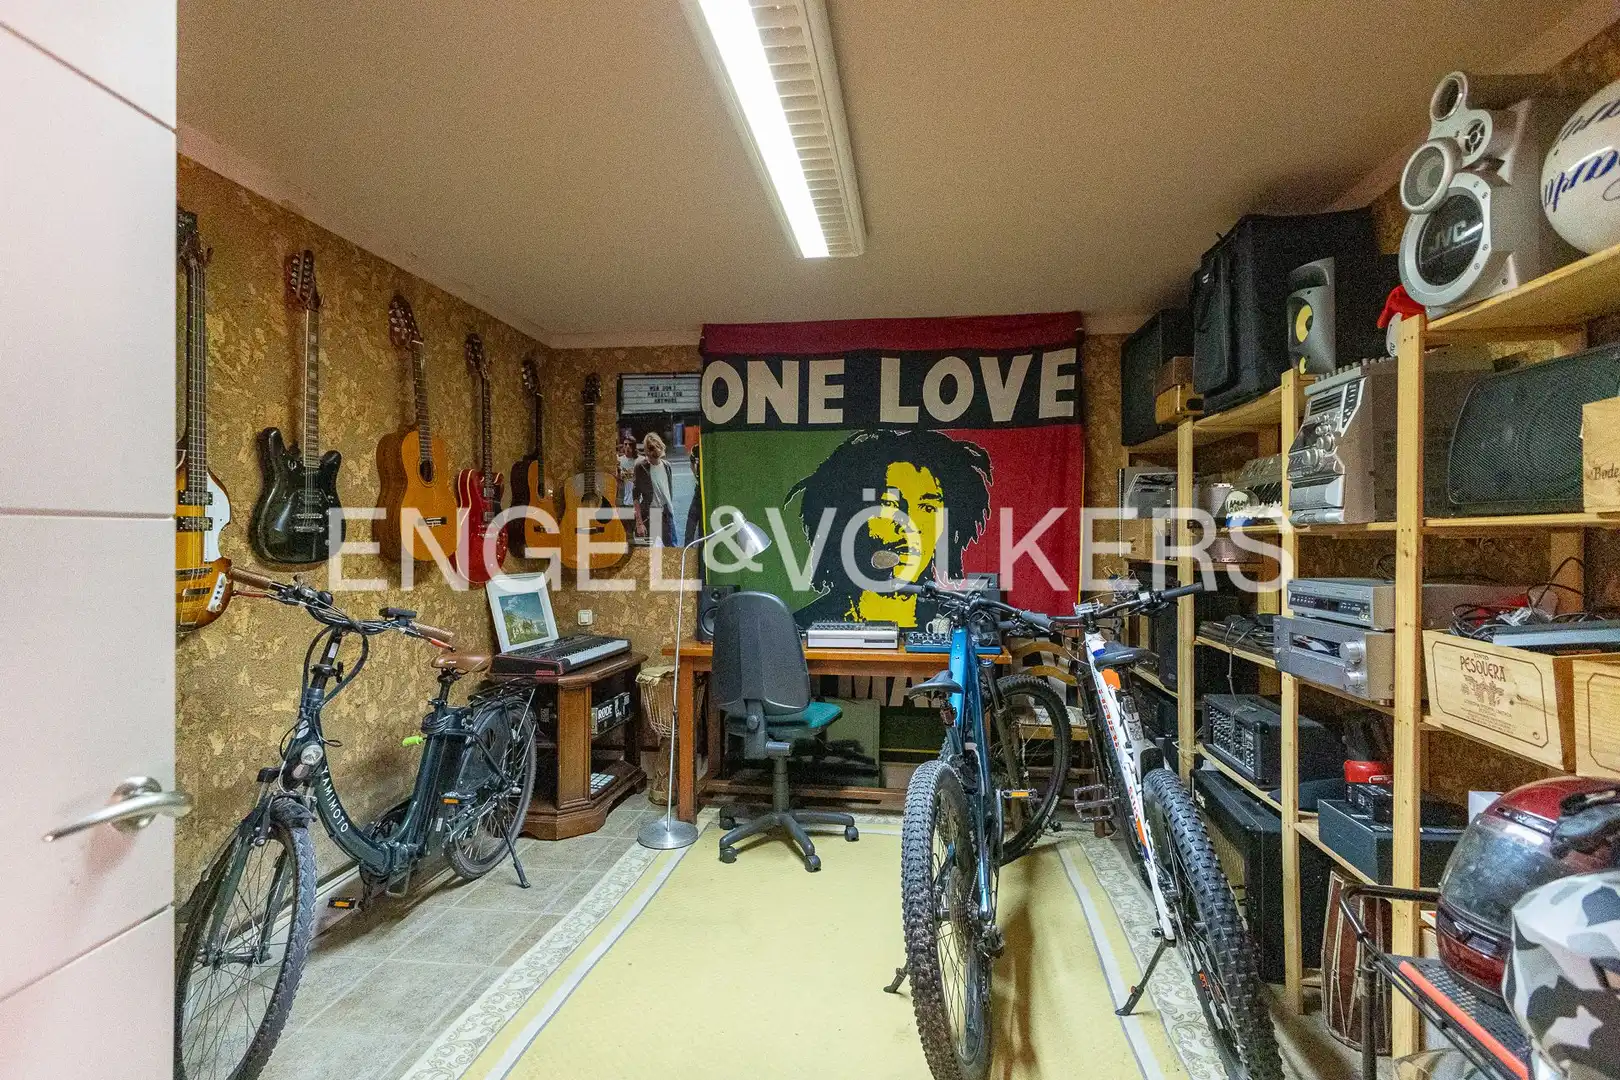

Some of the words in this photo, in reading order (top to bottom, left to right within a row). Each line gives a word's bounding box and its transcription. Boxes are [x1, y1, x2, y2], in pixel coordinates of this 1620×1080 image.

[702, 358, 845, 424] ONE
[880, 348, 1077, 423] LOVE
[1592, 462, 1620, 482] Bode
[1460, 655, 1506, 682] PESQUERA
[321, 766, 349, 832] YAMIMOTO
